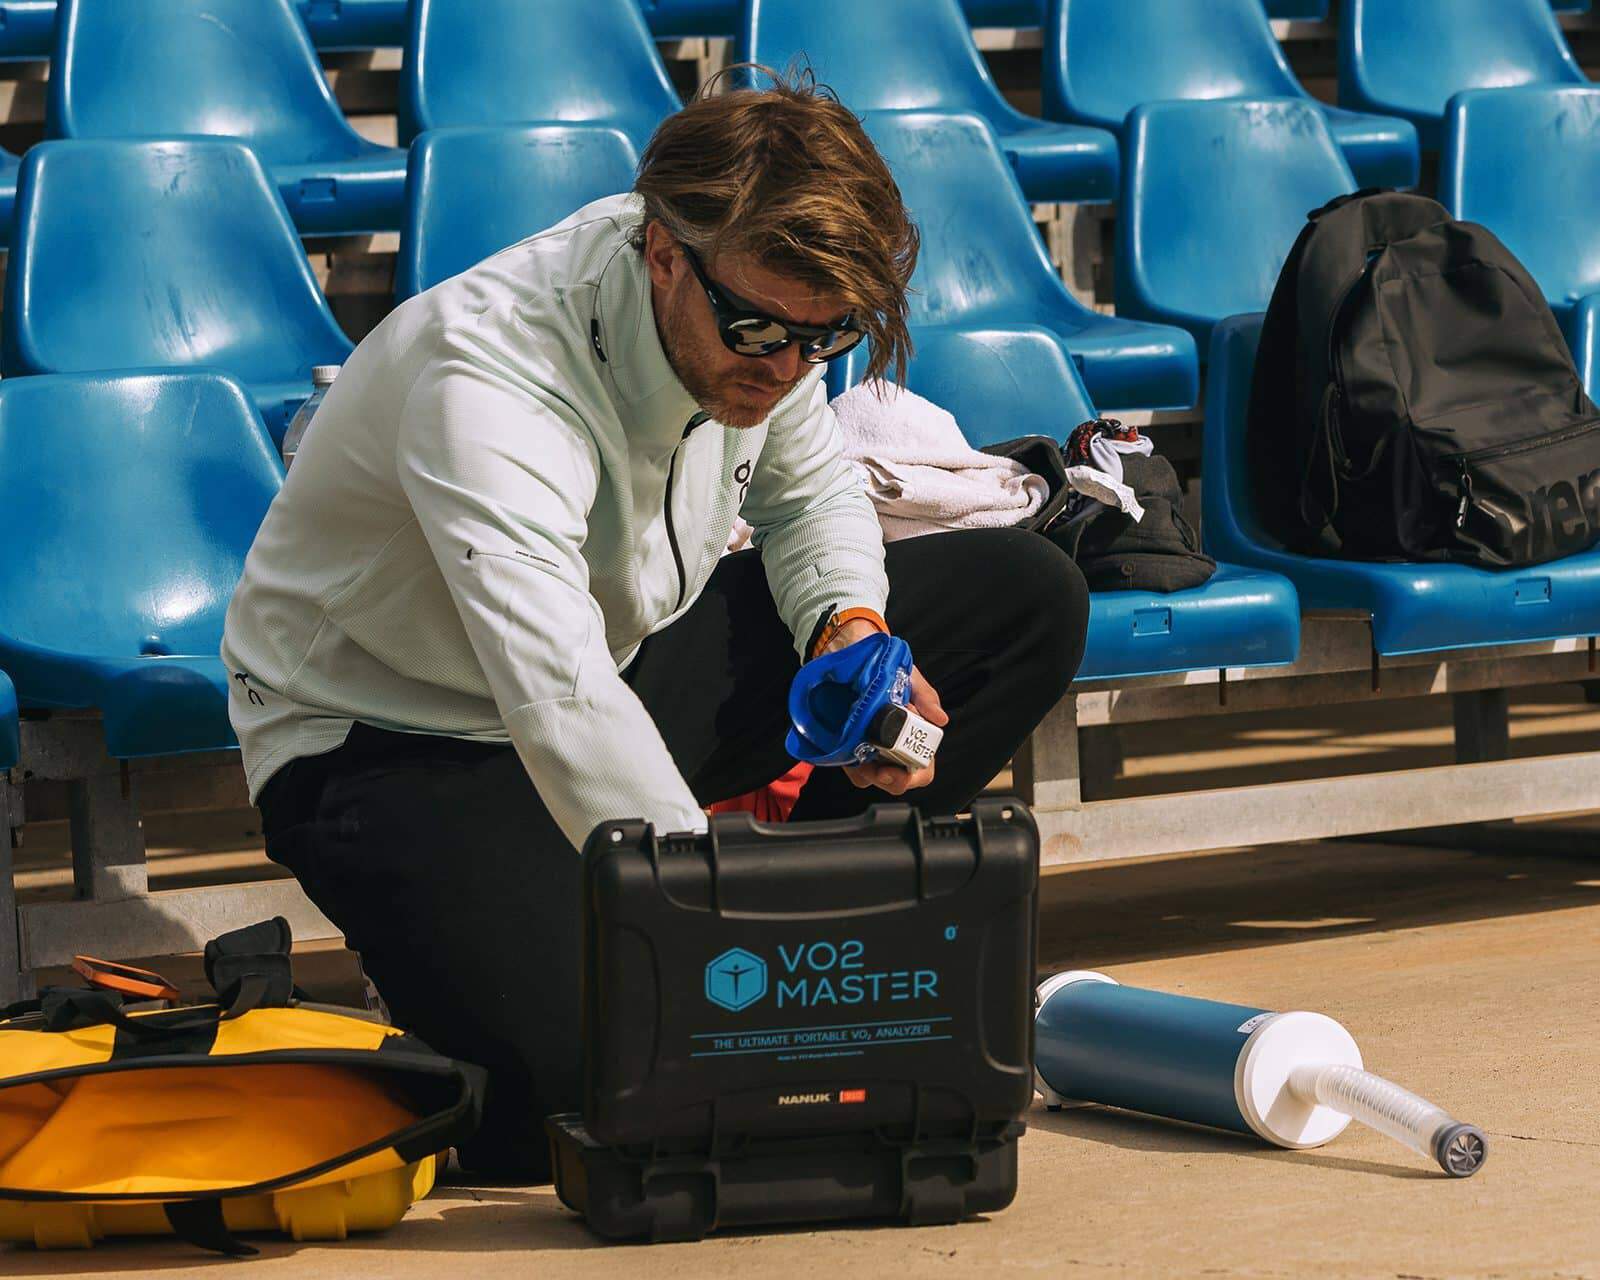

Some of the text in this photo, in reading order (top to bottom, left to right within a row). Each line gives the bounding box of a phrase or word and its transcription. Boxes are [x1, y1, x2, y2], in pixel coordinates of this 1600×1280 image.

[911, 726, 928, 743] VO2
[903, 737, 934, 760] MASTER
[777, 940, 864, 972] VO2
[777, 970, 938, 1008] MASTER
[713, 1039, 734, 1049] THE
[739, 1034, 788, 1048] ULTIMATE
[794, 1030, 847, 1044] PORTABLE
[876, 1024, 931, 1038] ANALYZER
[778, 1092, 830, 1105] NANUK
